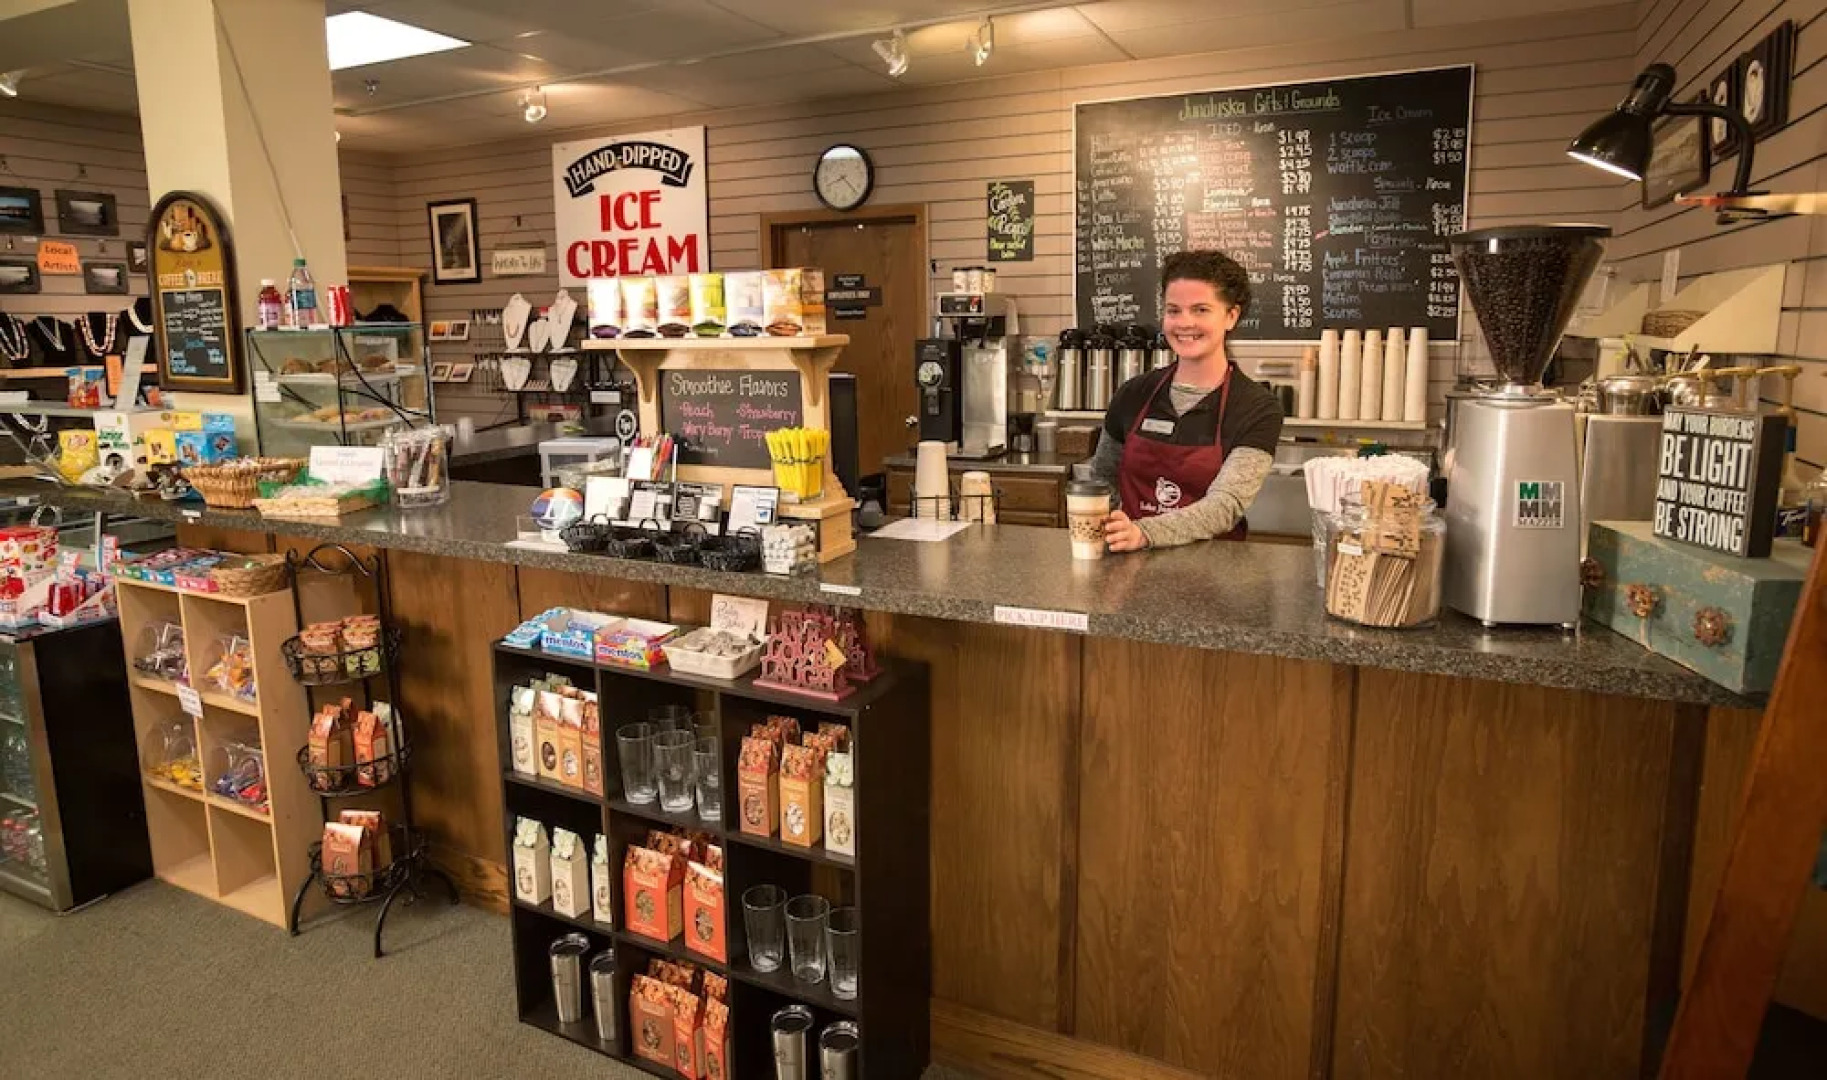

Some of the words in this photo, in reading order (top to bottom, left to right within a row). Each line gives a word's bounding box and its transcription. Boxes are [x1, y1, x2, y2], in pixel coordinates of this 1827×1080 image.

[1291, 88, 1340, 109] Grounds
[1340, 131, 1377, 146] Scoop
[571, 145, 681, 185] HAND-DIPPED
[599, 189, 662, 232] ICE
[45, 245, 72, 255] Local
[566, 233, 699, 279] CREAM
[44, 260, 78, 272] Artists
[670, 372, 735, 396] Smoothie
[739, 374, 789, 397] Flavors
[1660, 434, 1688, 478] BE
[1689, 436, 1753, 489] LIGHT
[1656, 478, 1678, 501] AND
[1679, 481, 1706, 507] YOUR
[1706, 487, 1748, 515] COFFEE
[1654, 501, 1676, 537] BE
[1676, 505, 1744, 553] STRONG
[996, 608, 1030, 624] PICK
[1031, 612, 1049, 626] UP
[1051, 613, 1087, 630] HERE
[545, 636, 588, 651] mentos
[599, 645, 644, 661] mentos
